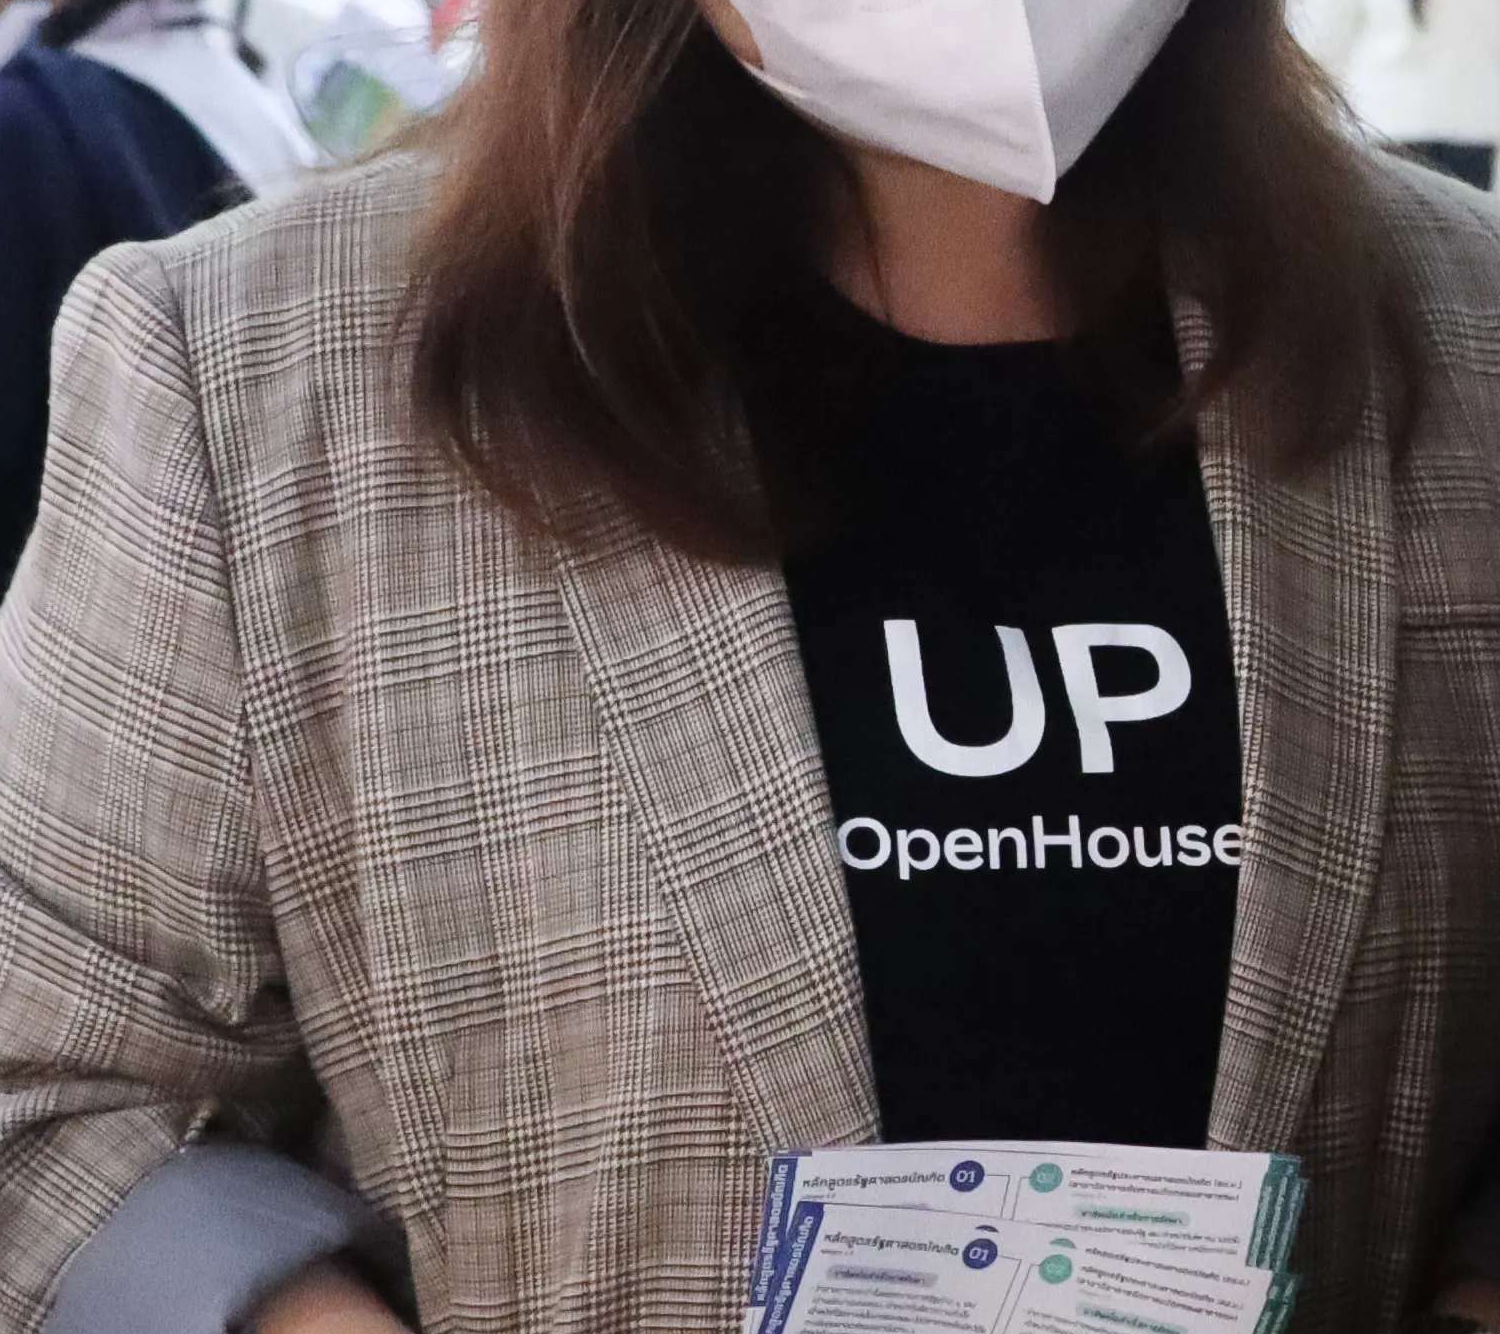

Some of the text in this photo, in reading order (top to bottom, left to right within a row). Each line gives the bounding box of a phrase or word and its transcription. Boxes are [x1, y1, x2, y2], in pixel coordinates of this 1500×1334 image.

[883, 619, 1192, 777] UP
[838, 814, 1245, 881] OpenHouse
[802, 1173, 945, 1192] หลักสูตรรัฐศาสตรบัณฑิต
[956, 1169, 977, 1184] 01
[968, 1247, 990, 1263] 01
